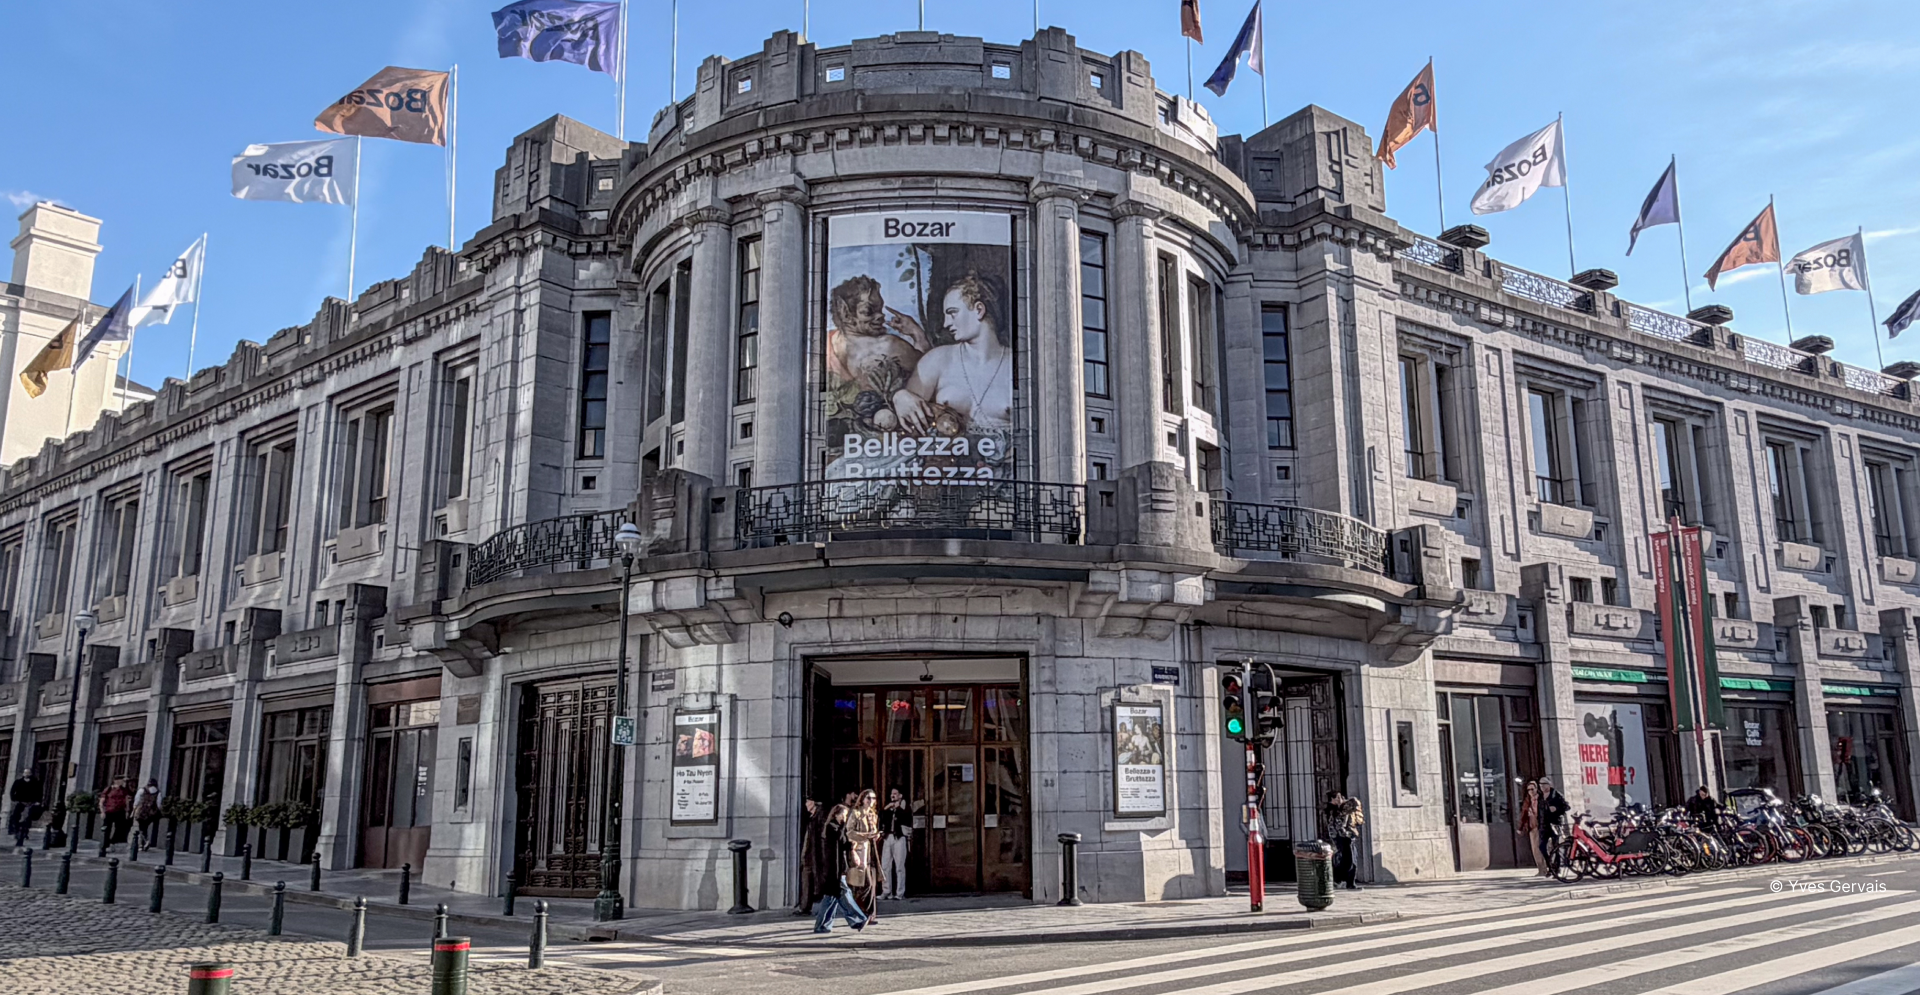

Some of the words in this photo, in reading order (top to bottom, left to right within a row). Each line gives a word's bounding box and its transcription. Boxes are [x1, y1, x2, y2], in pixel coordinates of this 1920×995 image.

[884, 217, 956, 238] Bozar
[843, 431, 970, 458] Bellezza
[977, 436, 996, 457] e
[845, 462, 994, 486] Bruttezza
